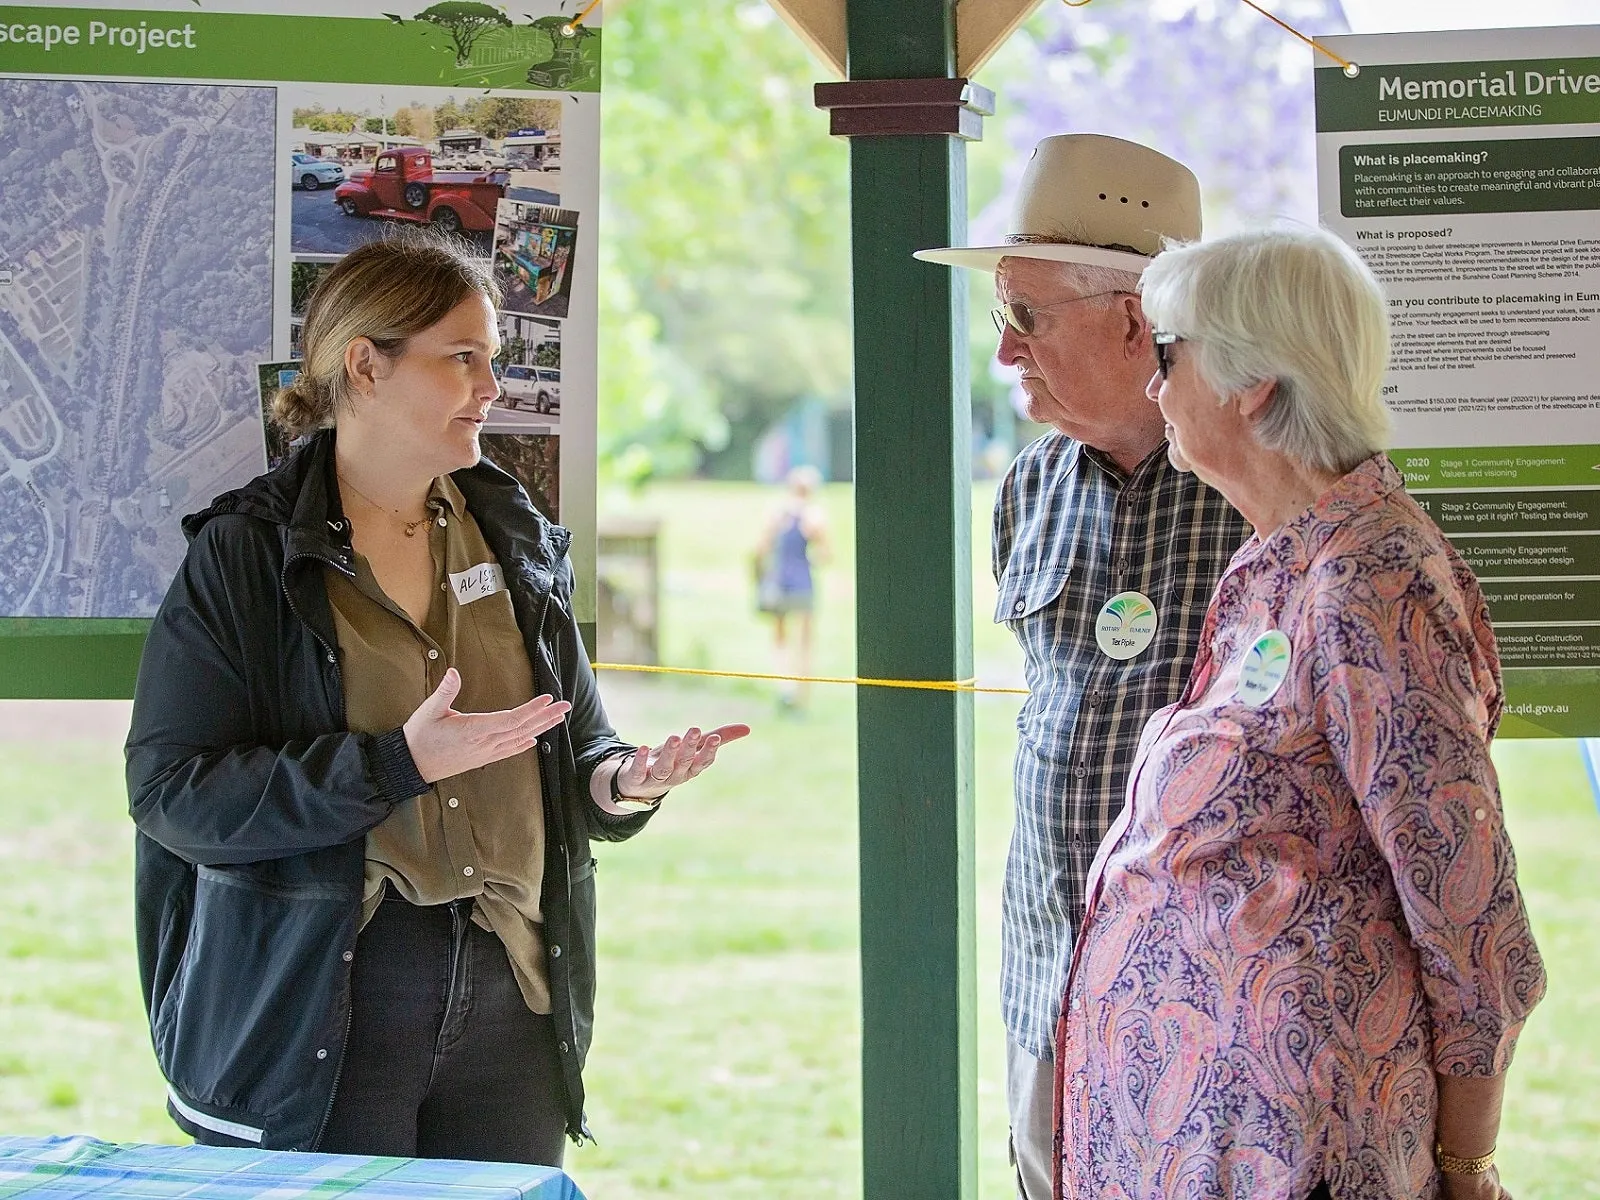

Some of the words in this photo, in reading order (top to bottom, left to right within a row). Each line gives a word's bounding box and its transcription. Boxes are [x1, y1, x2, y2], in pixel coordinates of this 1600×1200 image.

[0, 23, 80, 51] scape
[90, 21, 196, 54] Project
[1379, 71, 1516, 100] Memorial
[1525, 69, 1600, 95] Drive
[1379, 108, 1441, 121] EUMUNDI
[1446, 105, 1541, 119] PLACEMAKING
[1354, 155, 1385, 166] What
[1389, 155, 1399, 164] is
[1403, 151, 1488, 166] placemaking?
[1354, 173, 1412, 183] Placemaking
[1414, 172, 1422, 180] is
[1438, 171, 1480, 181] approach
[1493, 169, 1536, 179] engaging
[1537, 168, 1554, 176] and
[1355, 186, 1375, 196] with
[1377, 185, 1435, 194] communities
[1438, 184, 1447, 192] to
[1449, 183, 1478, 192] create
[1481, 181, 1532, 192] meaningful
[1534, 180, 1551, 189] and
[1553, 180, 1585, 188] vibrant
[1355, 199, 1375, 208] that
[1377, 198, 1407, 207] reflect
[1410, 197, 1431, 206] their
[1433, 196, 1465, 205] values.
[1357, 231, 1382, 239] What
[1386, 230, 1394, 238] is
[1398, 228, 1452, 240] proposed?
[1406, 299, 1424, 308] you
[1428, 296, 1479, 305] contribute
[1496, 294, 1560, 304] placemaking
[1564, 293, 1573, 301] in
[1577, 293, 1599, 301] Eum
[1406, 458, 1430, 467] 2020
[1472, 459, 1513, 467] Community
[1516, 458, 1566, 468] Engagement:
[1484, 469, 1517, 478] visioning
[1441, 503, 1463, 512] Stage
[1473, 502, 1515, 512] Community
[1518, 502, 1567, 510] Engagement:
[1477, 513, 1488, 522] got
[1497, 512, 1517, 521] right?
[1521, 512, 1547, 520] Testing
[1563, 511, 1588, 520] design
[1474, 547, 1516, 555] Community
[1519, 546, 1568, 555] Engagement:
[1485, 558, 1502, 566] your
[1550, 556, 1574, 564] design
[1504, 704, 1568, 715] st.qld.gov.au
